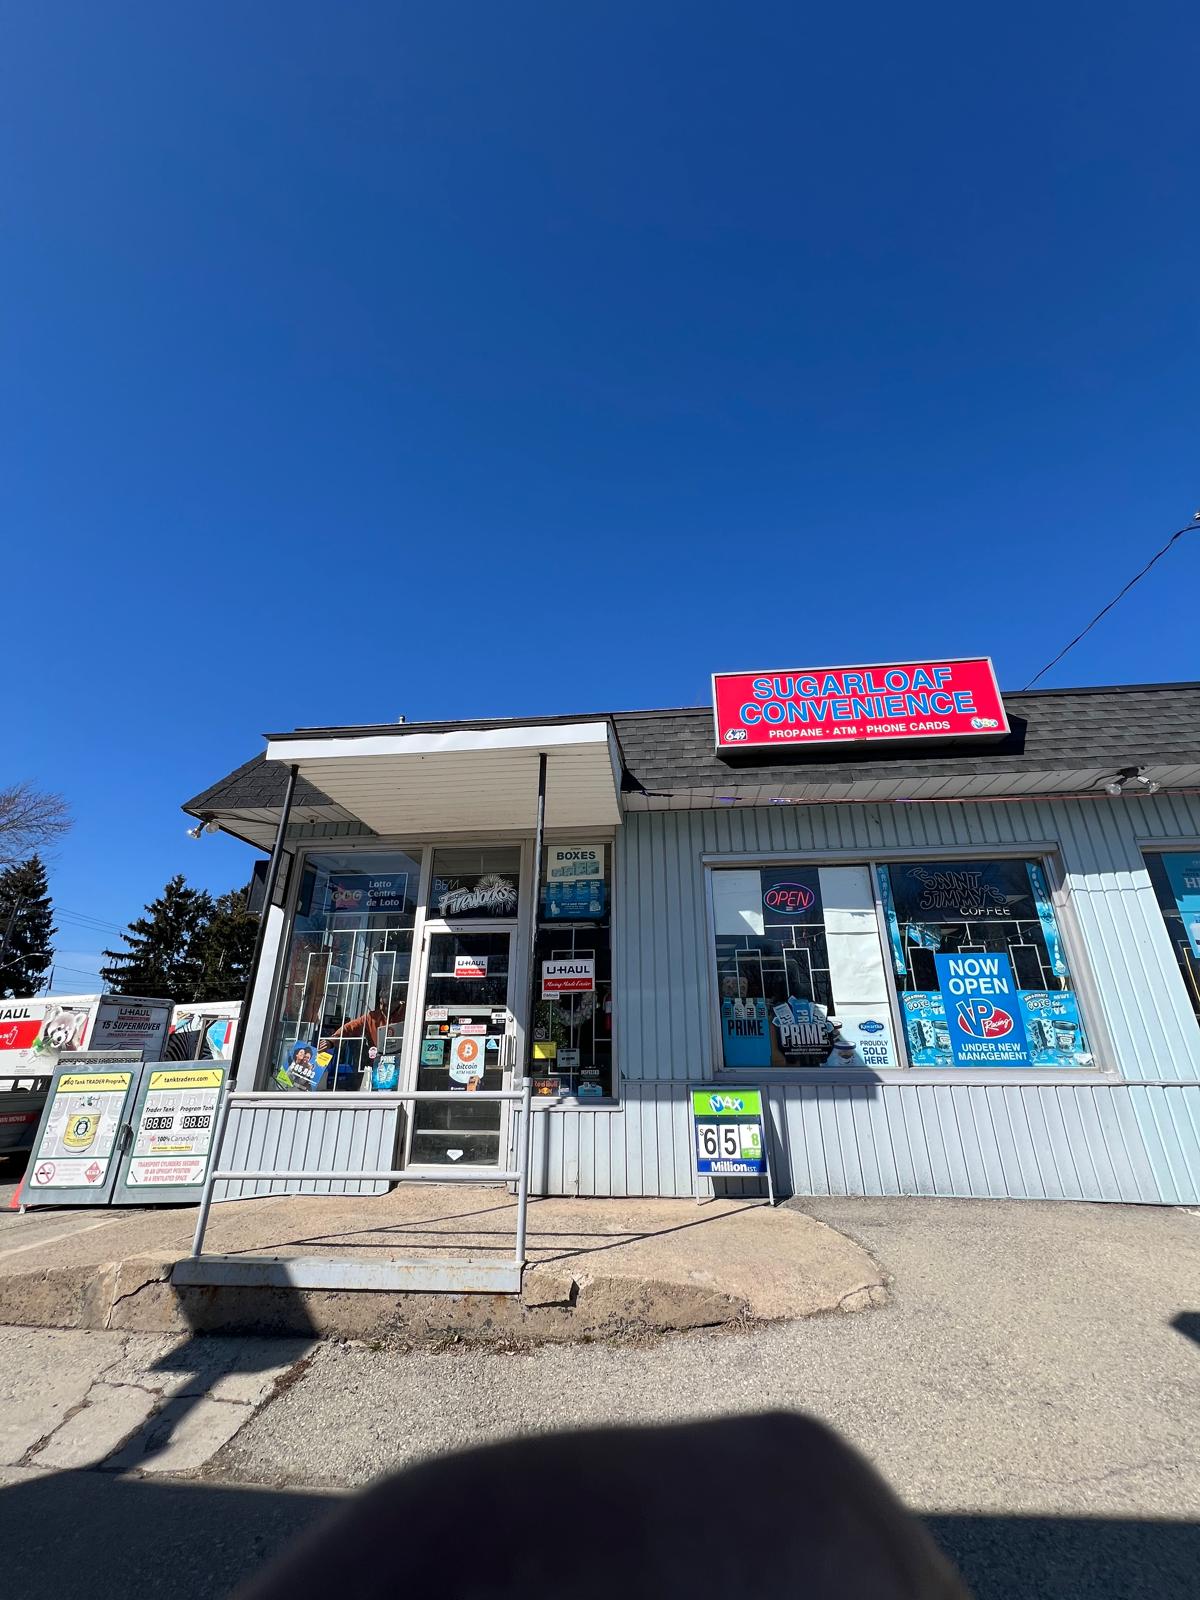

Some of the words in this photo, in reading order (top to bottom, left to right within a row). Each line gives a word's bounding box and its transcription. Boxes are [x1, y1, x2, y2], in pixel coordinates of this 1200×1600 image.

[752, 667, 952, 700] SUGARLOAF
[739, 691, 977, 725] CONVENIENCE
[769, 728, 823, 738] PROPANE
[833, 726, 857, 735] ATM
[867, 723, 907, 733] PHONE
[909, 720, 950, 731] CARDS
[557, 851, 597, 861] BOXES
[368, 880, 393, 889] Lotto
[919, 871, 983, 891] SAINT
[367, 889, 397, 898] Centre
[766, 890, 810, 907] OPEN
[919, 884, 1008, 911] JIMMY'S
[366, 898, 377, 907] de
[379, 897, 400, 906] Loto
[959, 907, 1012, 916] COFFEE
[547, 965, 590, 975] U-HAUL
[949, 958, 999, 976] NOW
[948, 977, 1009, 996] OPEN
[728, 1019, 766, 1037] PRIME
[984, 1017, 1011, 1033] Racing
[780, 1023, 829, 1047] PRIME
[862, 1047, 887, 1055] SOLD
[961, 1043, 994, 1052] UNDER
[997, 1043, 1021, 1052] NEW
[864, 1056, 890, 1064] HERE
[957, 1052, 1028, 1062] MANAGEMENT
[164, 1075, 208, 1083] tanktraders.com
[709, 1094, 745, 1113] MAX
[711, 1160, 748, 1172] Million
